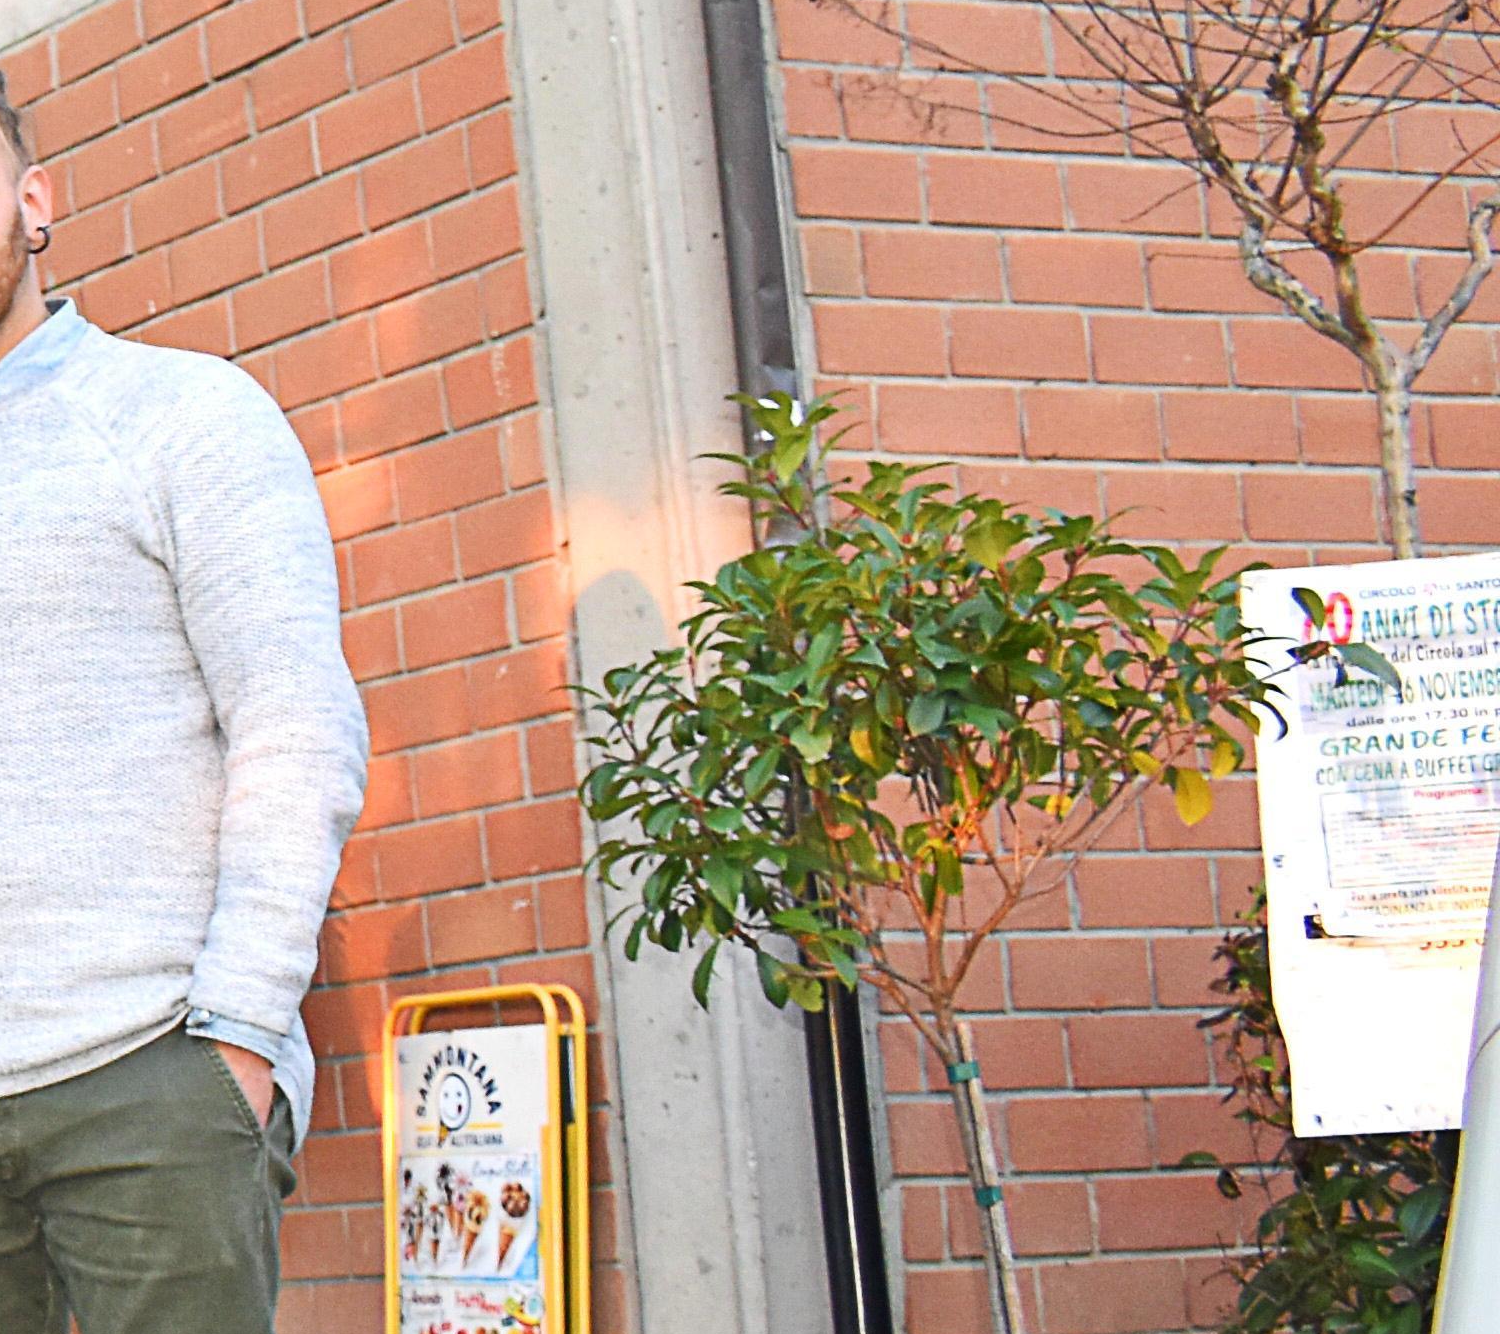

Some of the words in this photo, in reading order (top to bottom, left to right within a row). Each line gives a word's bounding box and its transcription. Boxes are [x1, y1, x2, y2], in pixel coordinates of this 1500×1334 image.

[1359, 586, 1416, 599] CIRCOLO
[1362, 604, 1420, 643] ANNI
[1428, 601, 1455, 639] DI
[1391, 643, 1411, 664] del
[1416, 640, 1463, 662] Circolo
[1468, 636, 1488, 657] sul
[1320, 728, 1449, 757] GRANDE
[1316, 765, 1348, 786] CON
[1354, 761, 1395, 782] CENA
[1415, 754, 1478, 778] BUFFET
[1414, 787, 1484, 800] Programma
